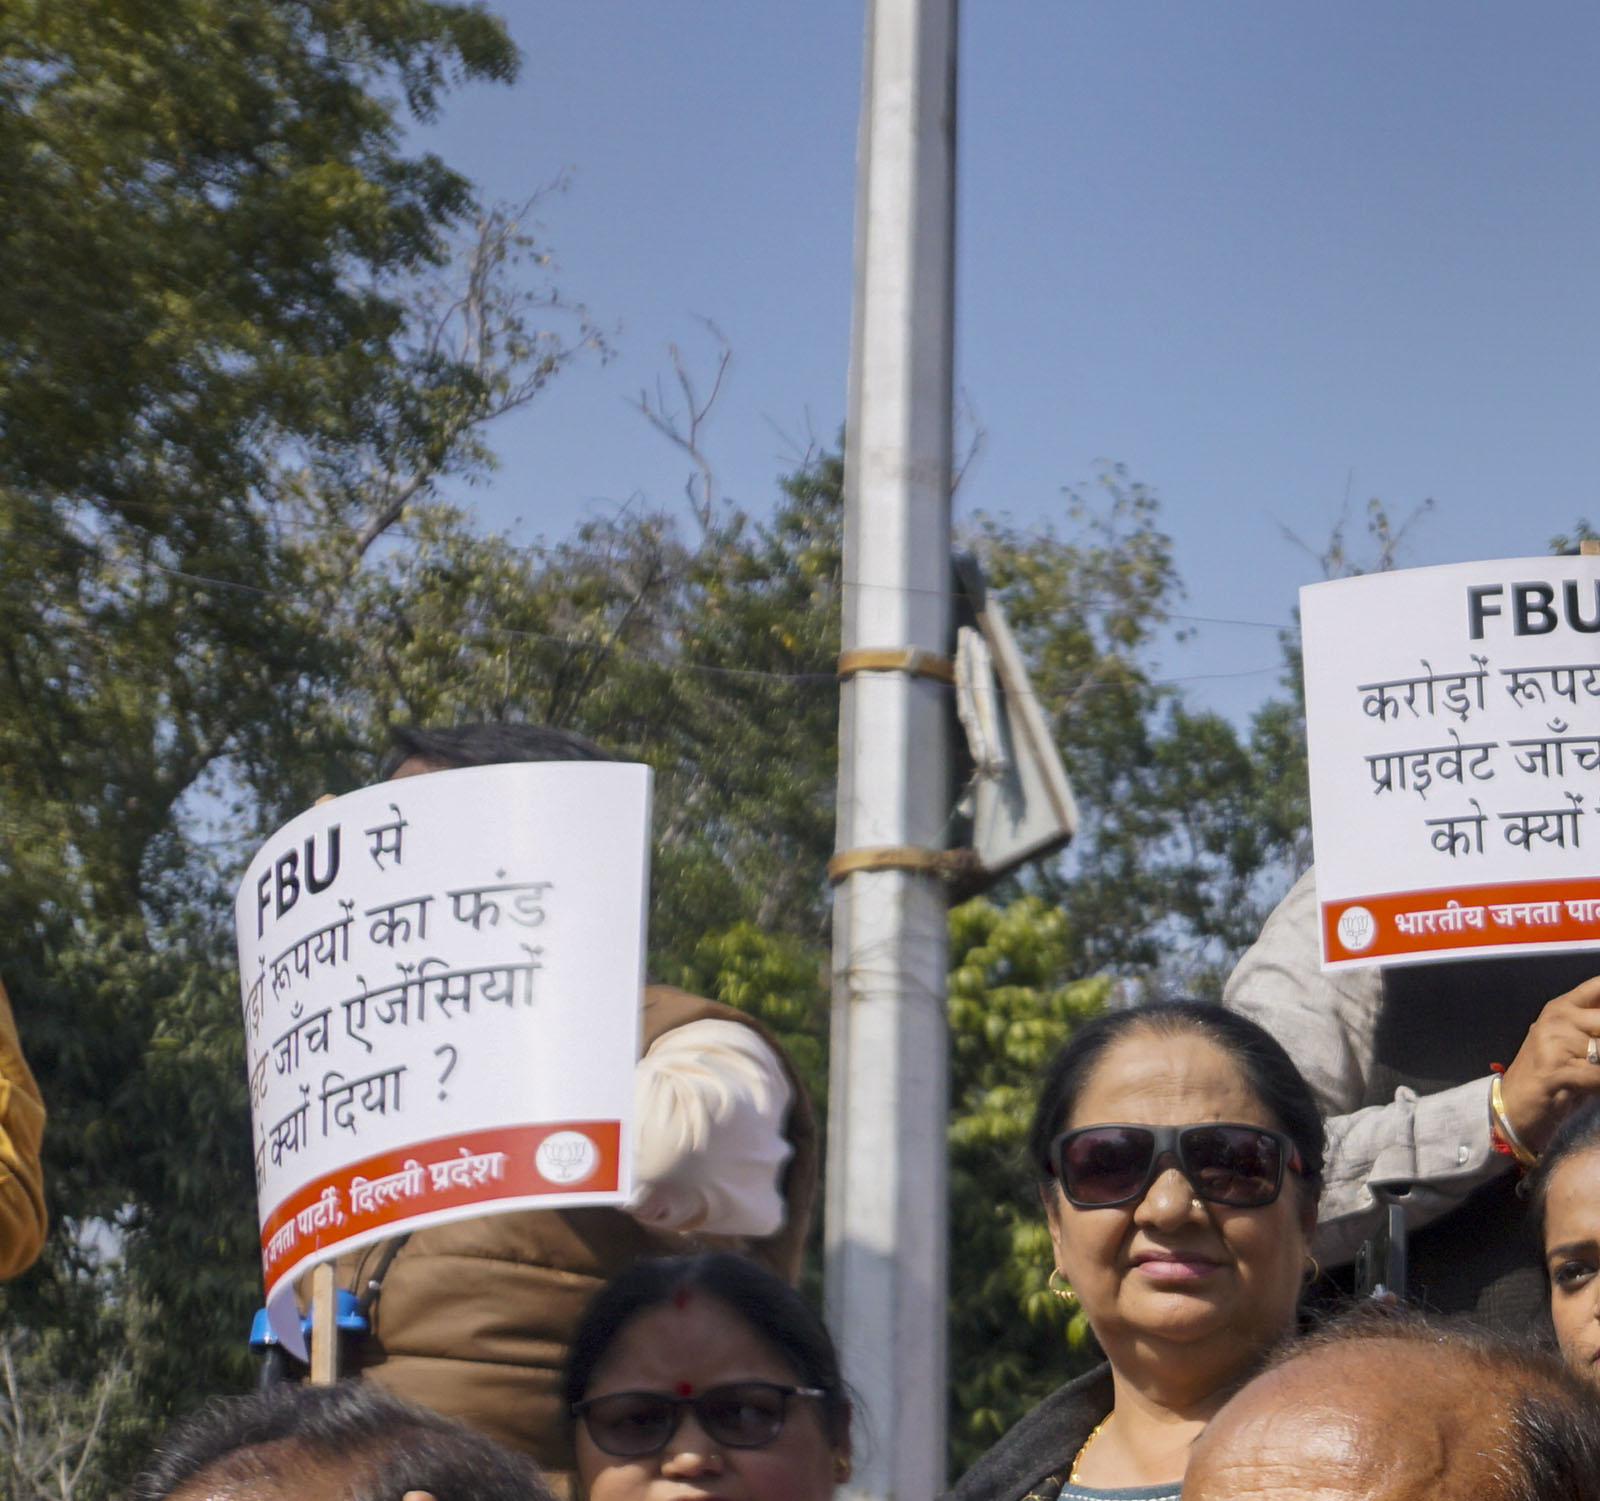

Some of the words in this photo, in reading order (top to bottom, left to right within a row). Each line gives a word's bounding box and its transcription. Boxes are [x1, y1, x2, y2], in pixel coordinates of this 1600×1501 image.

[1357, 654, 1489, 722] करोड़ों
[1364, 727, 1498, 800] प्राइवेट
[1425, 799, 1488, 857] को
[1498, 791, 1584, 852] क्यों
[257, 823, 341, 941] FBU
[364, 803, 409, 872] से
[269, 898, 355, 1003] रूपयों
[364, 894, 435, 948] का
[446, 868, 554, 931] फंड
[1395, 900, 1484, 935] भारतीय
[1492, 901, 1559, 927] जनता
[272, 1000, 333, 1075] जाँच
[268, 1083, 310, 1168] क्यों
[318, 1070, 408, 1138] दिया
[433, 1043, 458, 1103] ?
[349, 1160, 426, 1216] दिल्ली
[428, 1147, 505, 1191] प्रदेश
